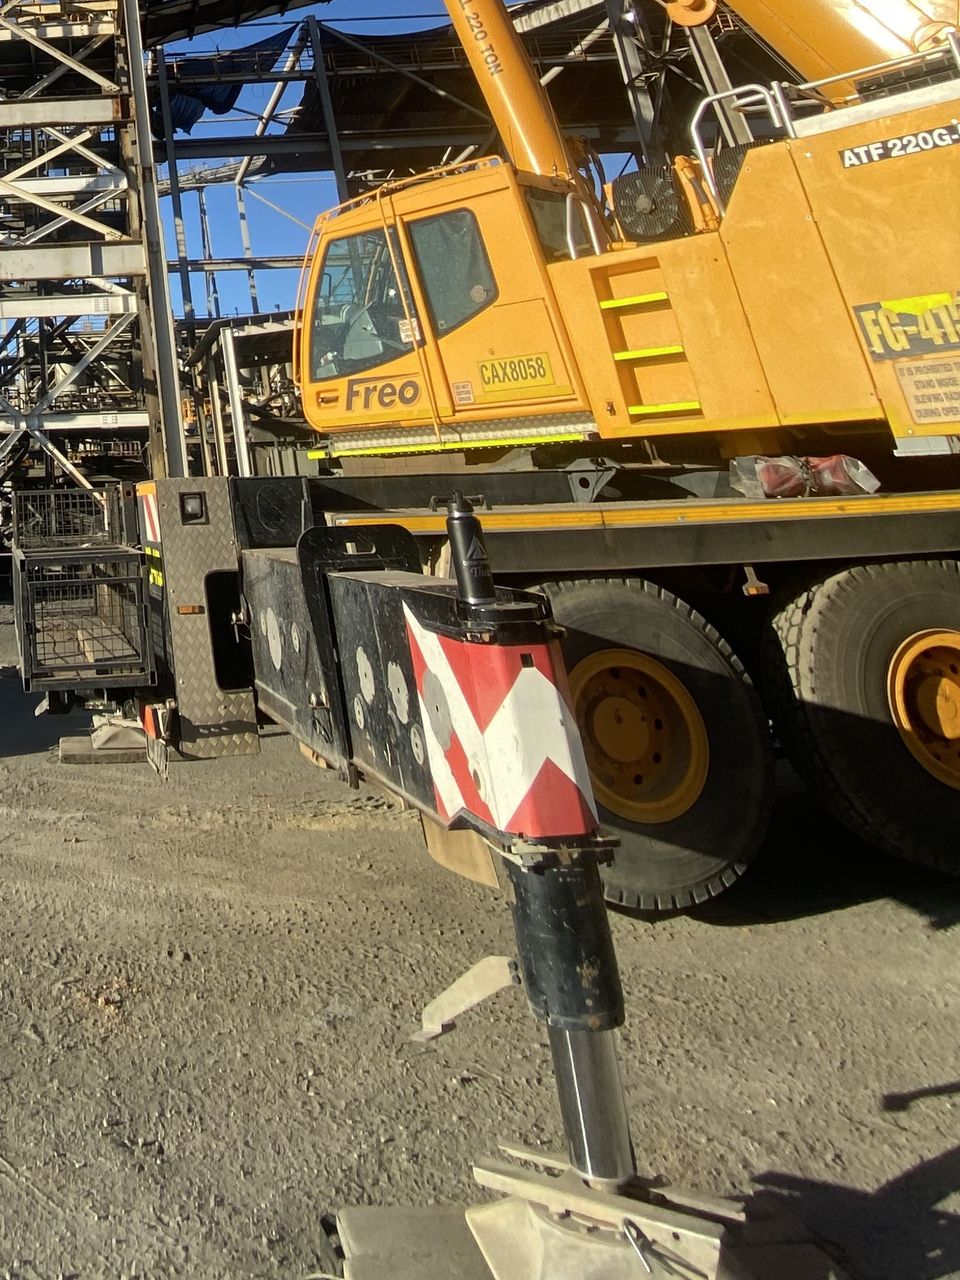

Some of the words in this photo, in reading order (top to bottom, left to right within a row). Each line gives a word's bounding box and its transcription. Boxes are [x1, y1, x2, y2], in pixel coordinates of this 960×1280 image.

[466, 12, 488, 42] 220
[480, 43, 504, 77] TON
[843, 143, 884, 168] ATF
[480, 357, 547, 386] CAX8058
[346, 373, 421, 411] Freo
